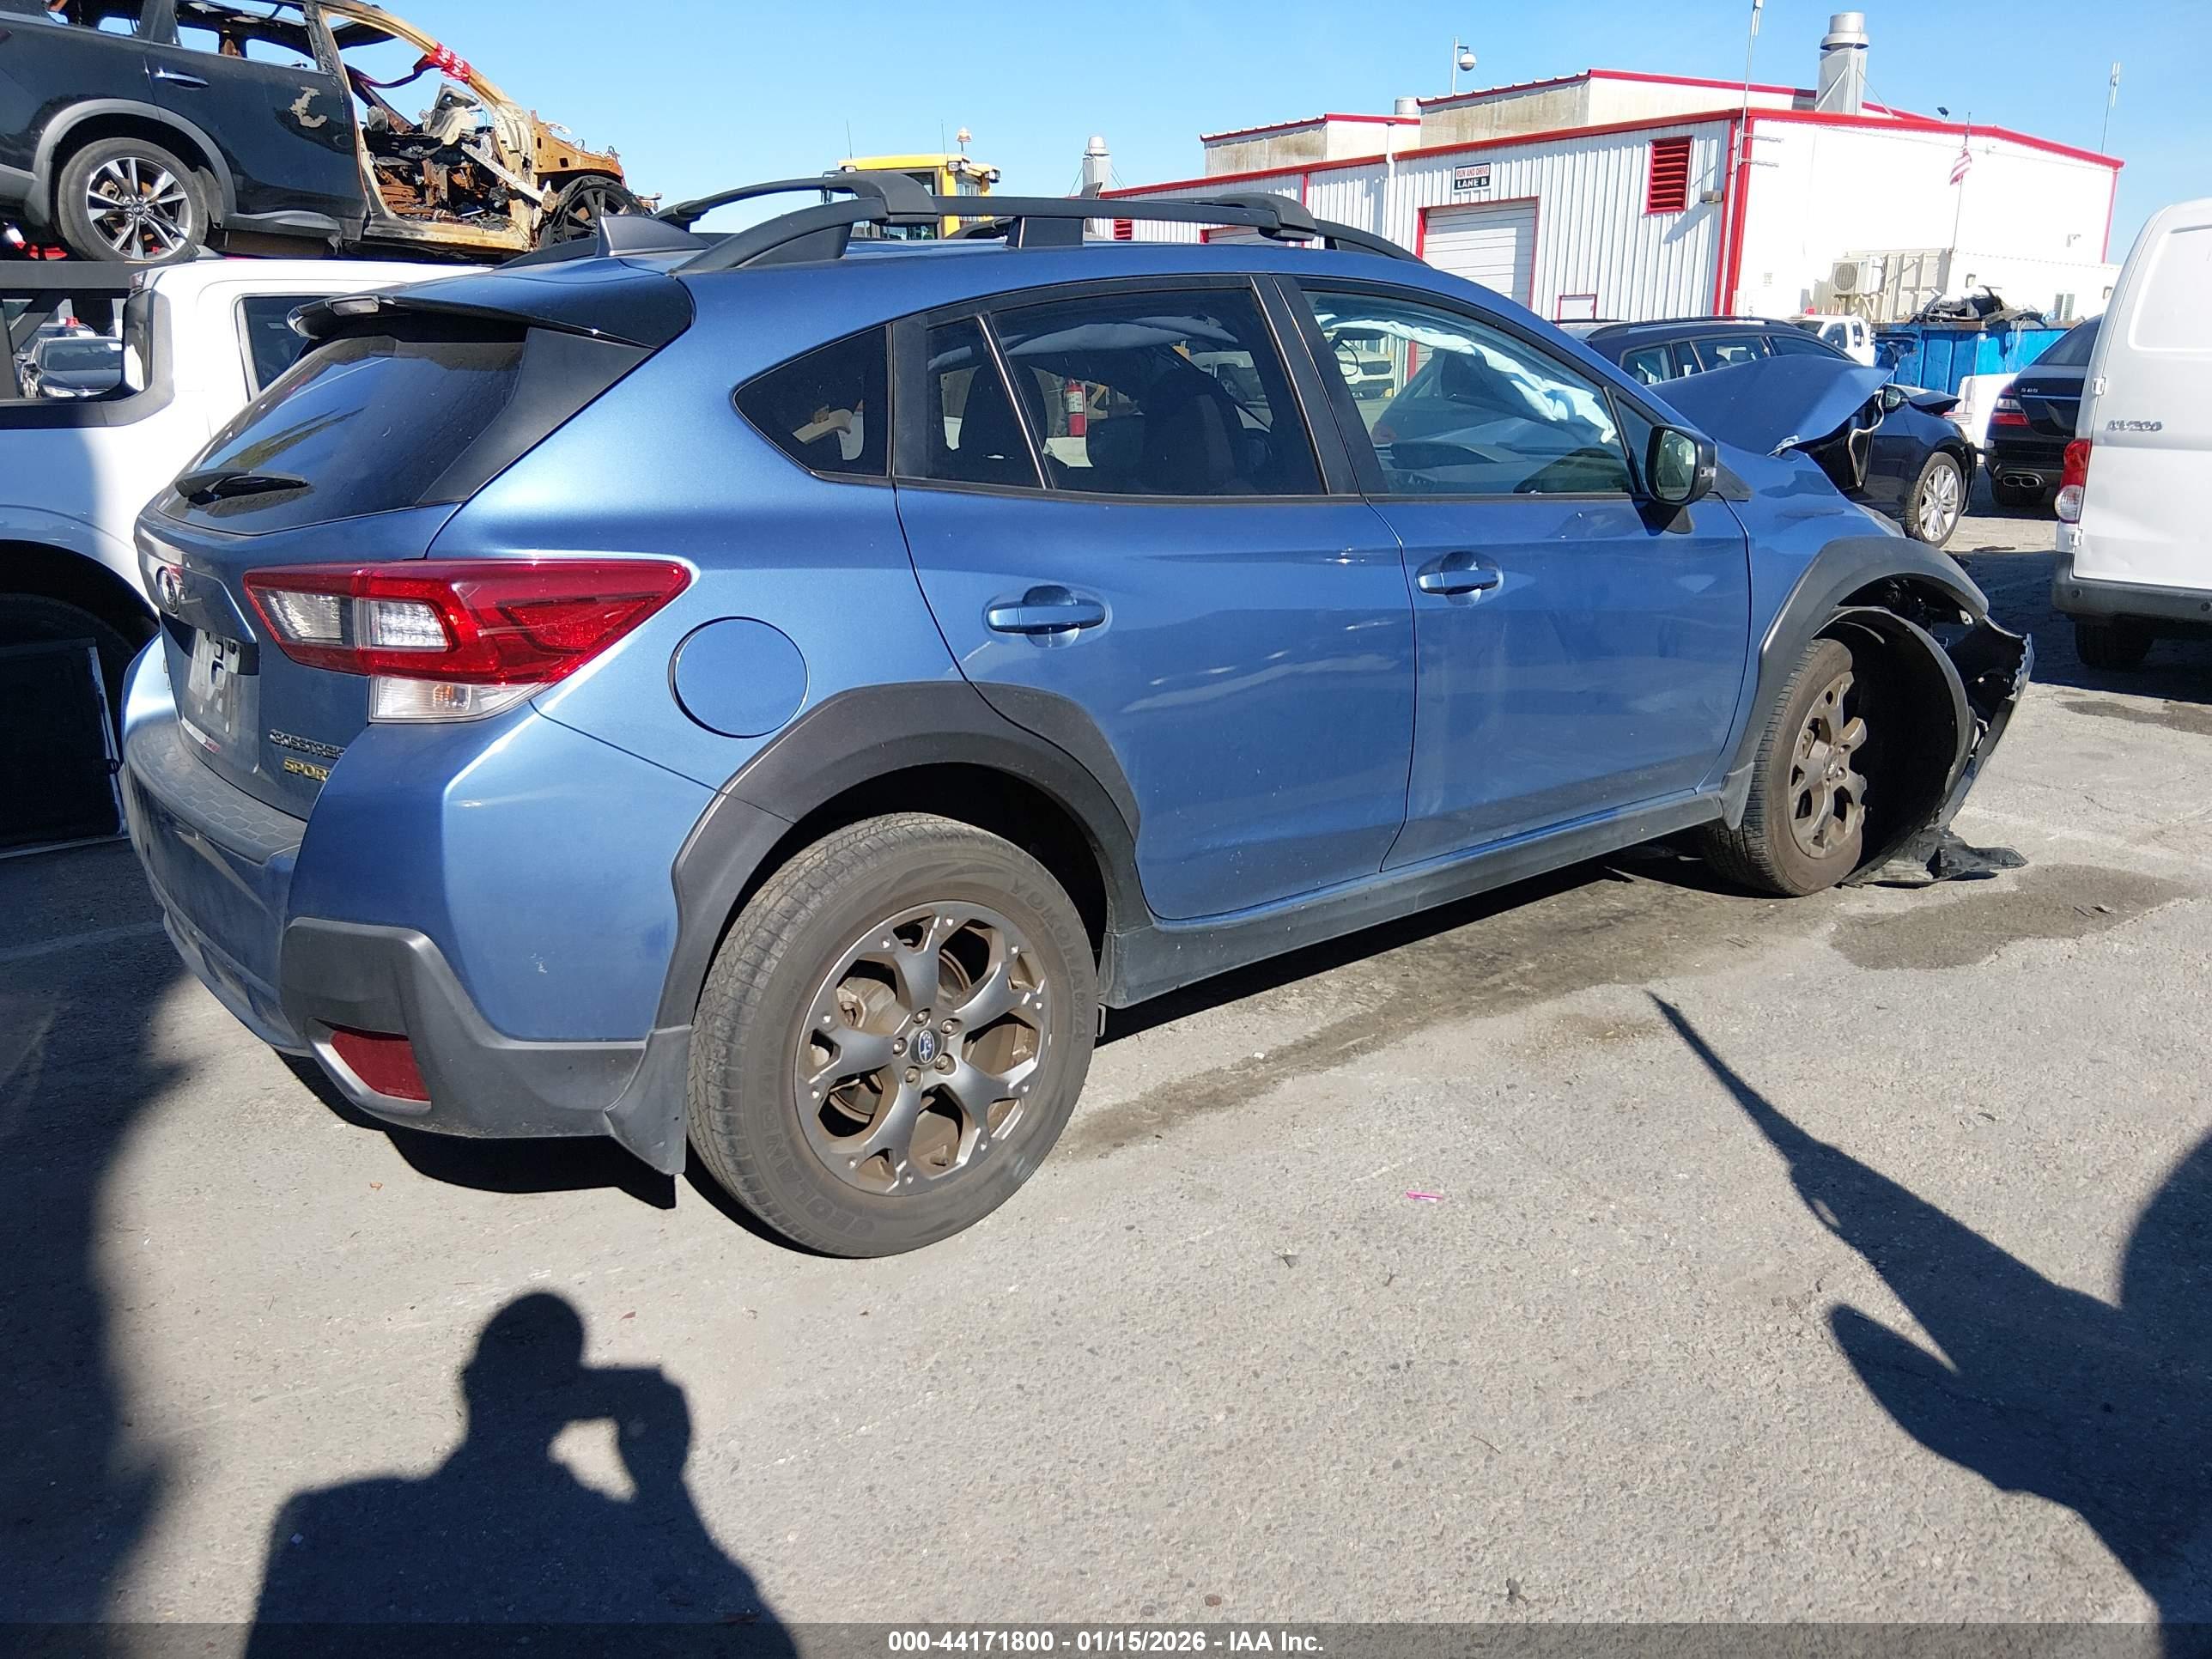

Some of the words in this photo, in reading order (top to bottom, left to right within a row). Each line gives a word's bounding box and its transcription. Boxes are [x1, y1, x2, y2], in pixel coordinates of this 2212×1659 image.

[1457, 168, 1466, 179] RUN
[1467, 167, 1475, 177] AND
[1476, 166, 1489, 176] DRIVE
[1457, 179, 1479, 188] LANE
[284, 757, 331, 783] SPOR
[1010, 878, 1086, 1042] YOKOHAMA
